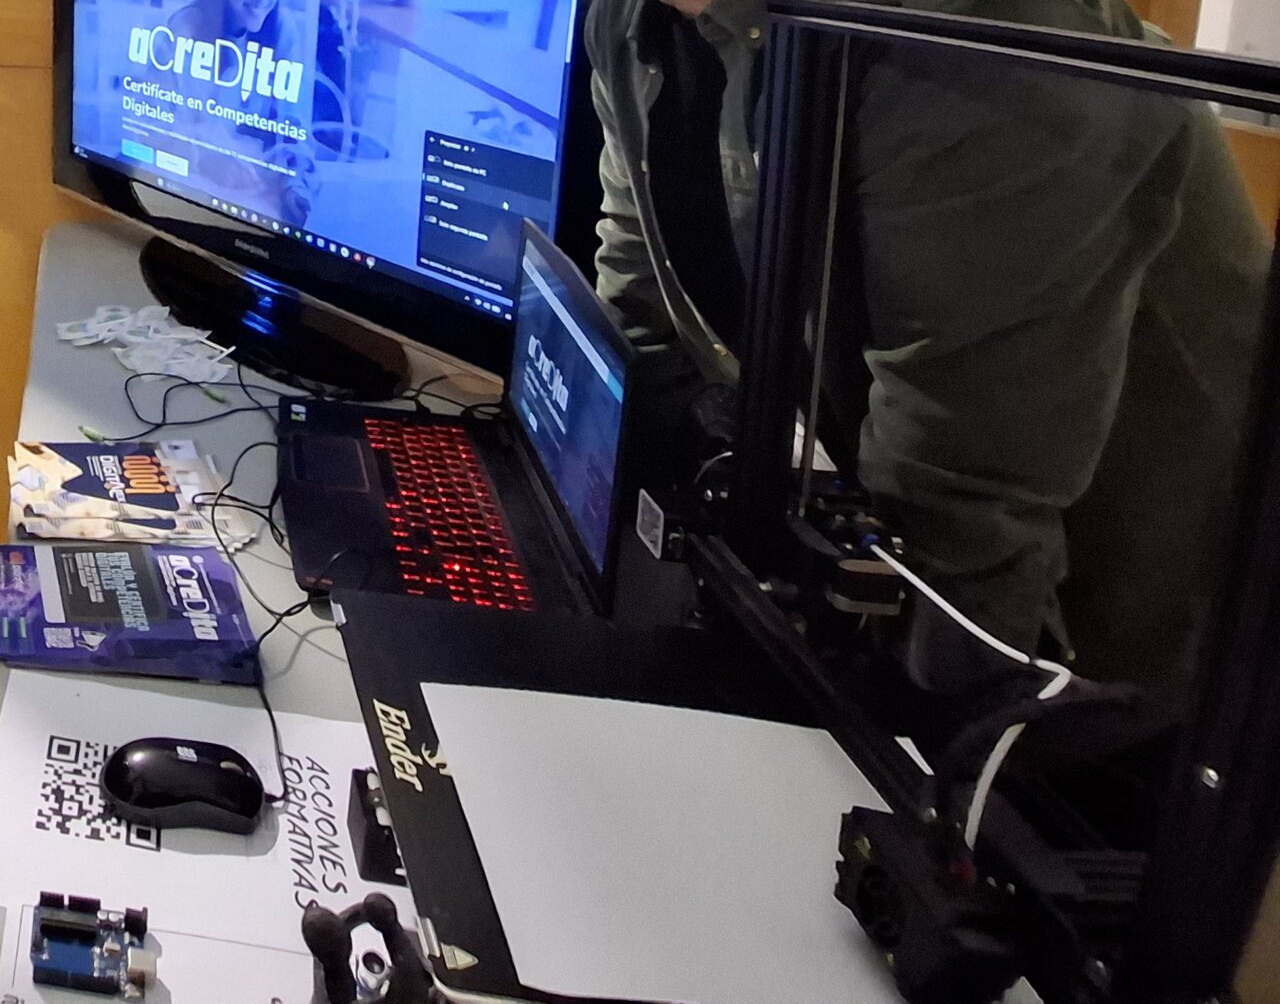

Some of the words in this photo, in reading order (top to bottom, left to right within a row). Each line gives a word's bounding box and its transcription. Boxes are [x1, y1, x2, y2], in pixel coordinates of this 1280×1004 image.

[122, 96, 175, 124] Digitales
[187, 97, 203, 111] en
[206, 99, 307, 141] Competencias
[373, 699, 424, 793] Ender
[280, 752, 320, 910] FORMATIVAS
[306, 756, 348, 894] ACCIONES
